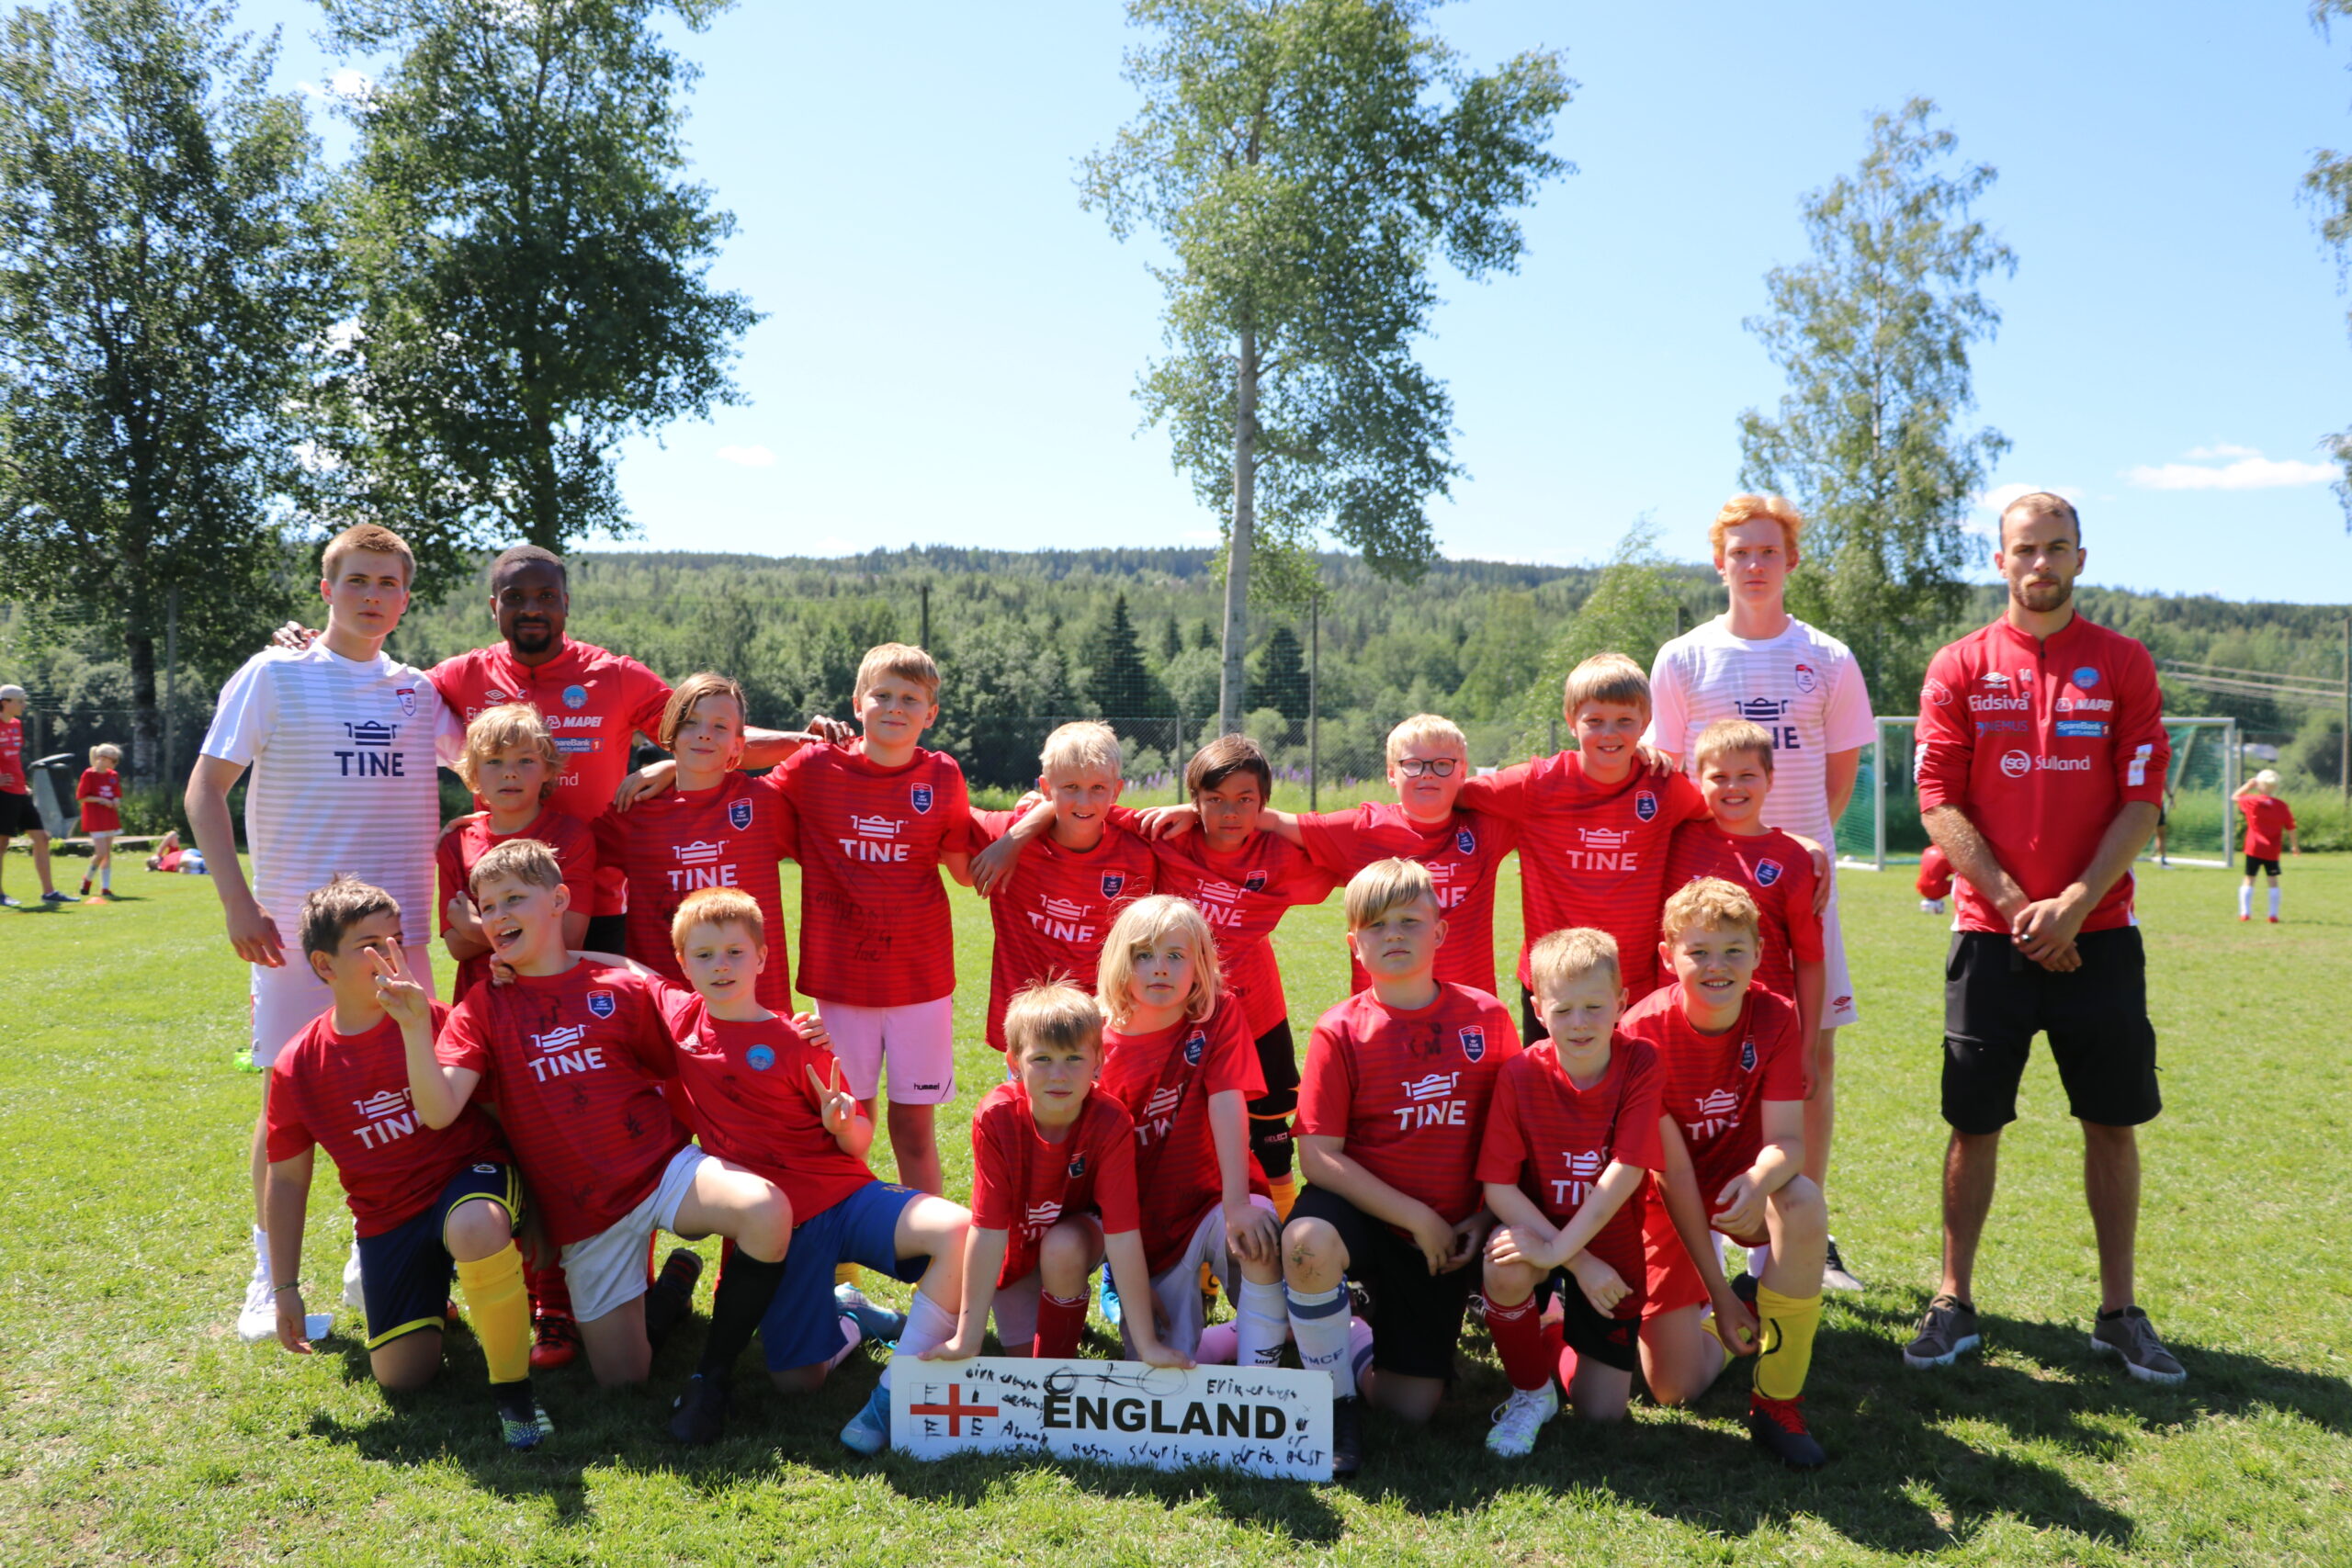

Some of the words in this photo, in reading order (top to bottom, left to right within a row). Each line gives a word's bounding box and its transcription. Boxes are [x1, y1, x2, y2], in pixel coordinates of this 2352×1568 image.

[1968, 693, 2030, 712] Eidsiva
[2075, 698, 2113, 712] MAPEI
[563, 716, 602, 728] MAPEI
[334, 751, 405, 777] TINE
[2035, 754, 2090, 771] Sulland
[839, 838, 910, 863] TINE
[1566, 850, 1638, 872] TINE
[667, 863, 738, 891] TINE
[1026, 911, 1096, 942] TINE
[528, 1046, 606, 1082] TINE
[1393, 1100, 1466, 1131] TINE
[1044, 1395, 1286, 1439] ENGLAND
